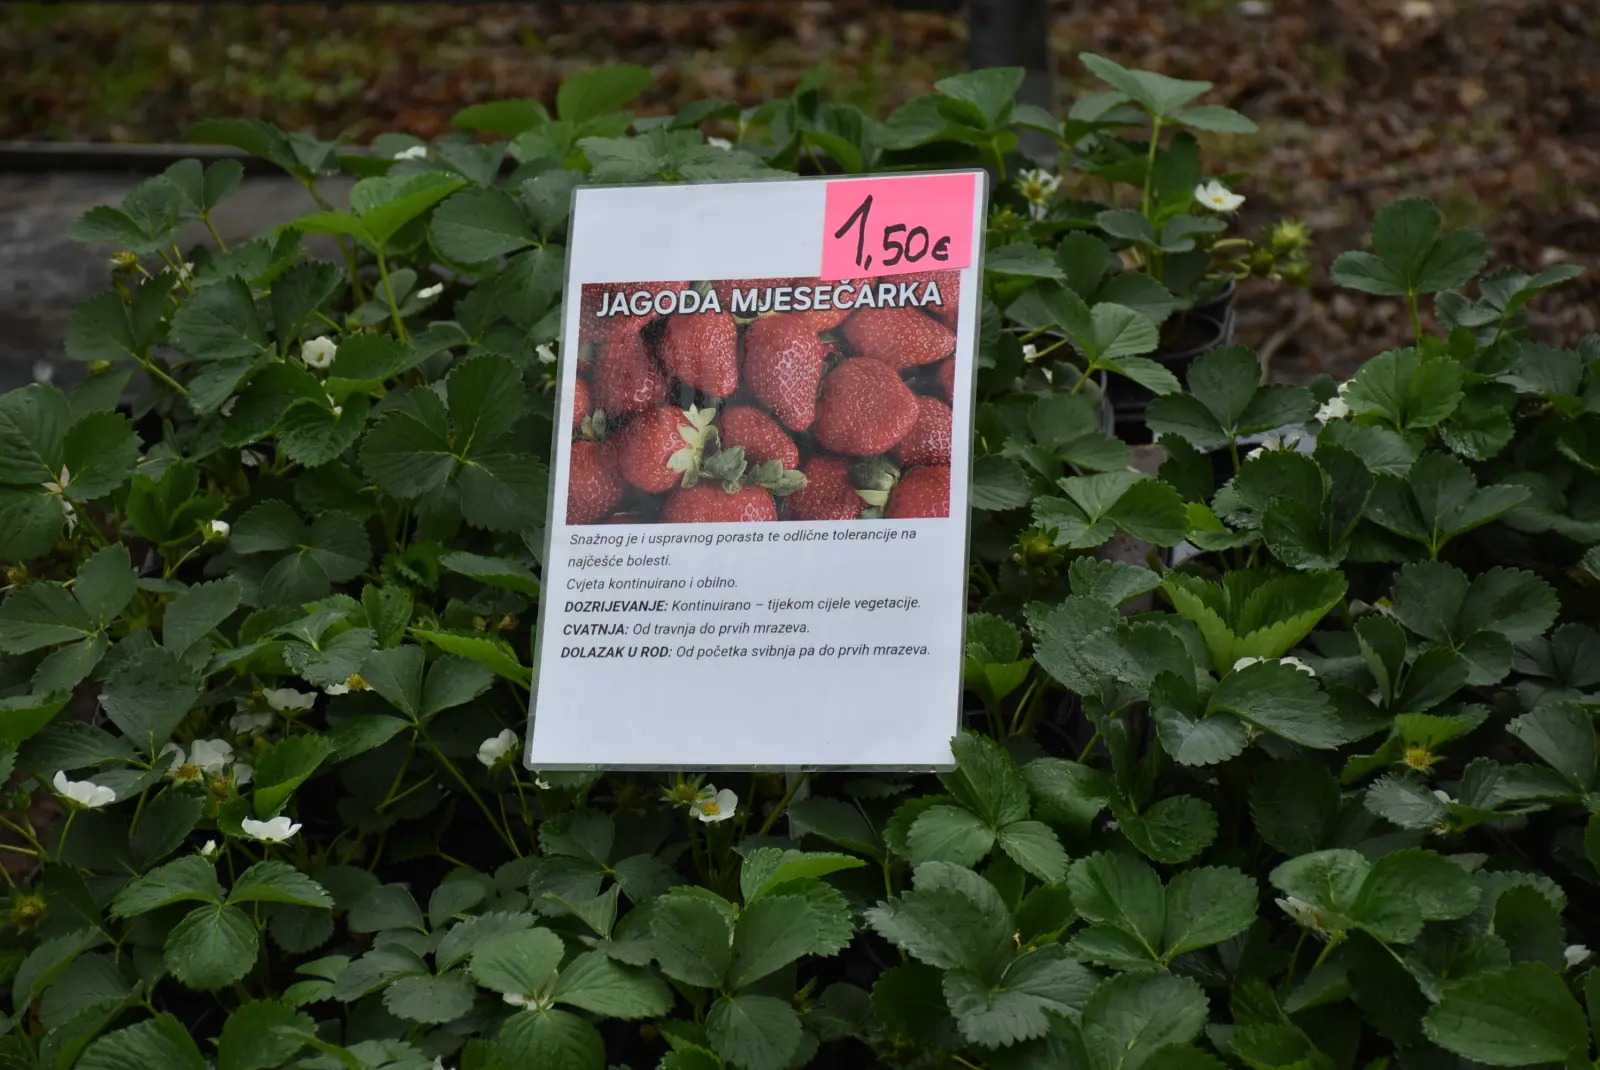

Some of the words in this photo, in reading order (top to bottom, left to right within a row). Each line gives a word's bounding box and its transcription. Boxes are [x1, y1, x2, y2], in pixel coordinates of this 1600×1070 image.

[596, 289, 721, 317] JAGODA
[731, 280, 943, 314] MJESEČARKA
[569, 534, 624, 547] Snažnog
[625, 533, 638, 547] je
[641, 533, 645, 545] i
[649, 533, 713, 546] uspravnog
[716, 531, 764, 545] porasta
[768, 532, 780, 542] te
[783, 529, 829, 541] odlične
[832, 528, 898, 542] tolerancije
[901, 530, 917, 540] na
[568, 555, 624, 569] najčešće
[627, 554, 671, 567] bolesti.
[566, 578, 605, 592] Cvjeta
[609, 577, 686, 590] kontinuirano
[689, 577, 694, 589] i
[697, 576, 738, 589] obilno.
[564, 600, 668, 612] DOZRIJEVANJE:
[672, 599, 751, 612] Kontinuirano
[768, 598, 814, 613] tijekom
[817, 597, 851, 612] cijele
[855, 597, 921, 611] vegetacije.
[563, 623, 629, 636] CVATNJA:
[633, 623, 650, 635] Od
[654, 623, 696, 637] travnja
[700, 622, 715, 634] do
[719, 622, 750, 637] prvih
[753, 623, 810, 634] mrazeva.
[560, 646, 624, 658] DOLAZAK
[628, 646, 637, 658] U
[640, 646, 672, 658] ROD:
[676, 645, 694, 658] Od
[697, 645, 747, 660] početka
[752, 645, 796, 659] svibnja
[798, 647, 815, 659] pa
[818, 644, 835, 656] do
[838, 644, 870, 658] prvih
[873, 645, 930, 656] mrazeva.
